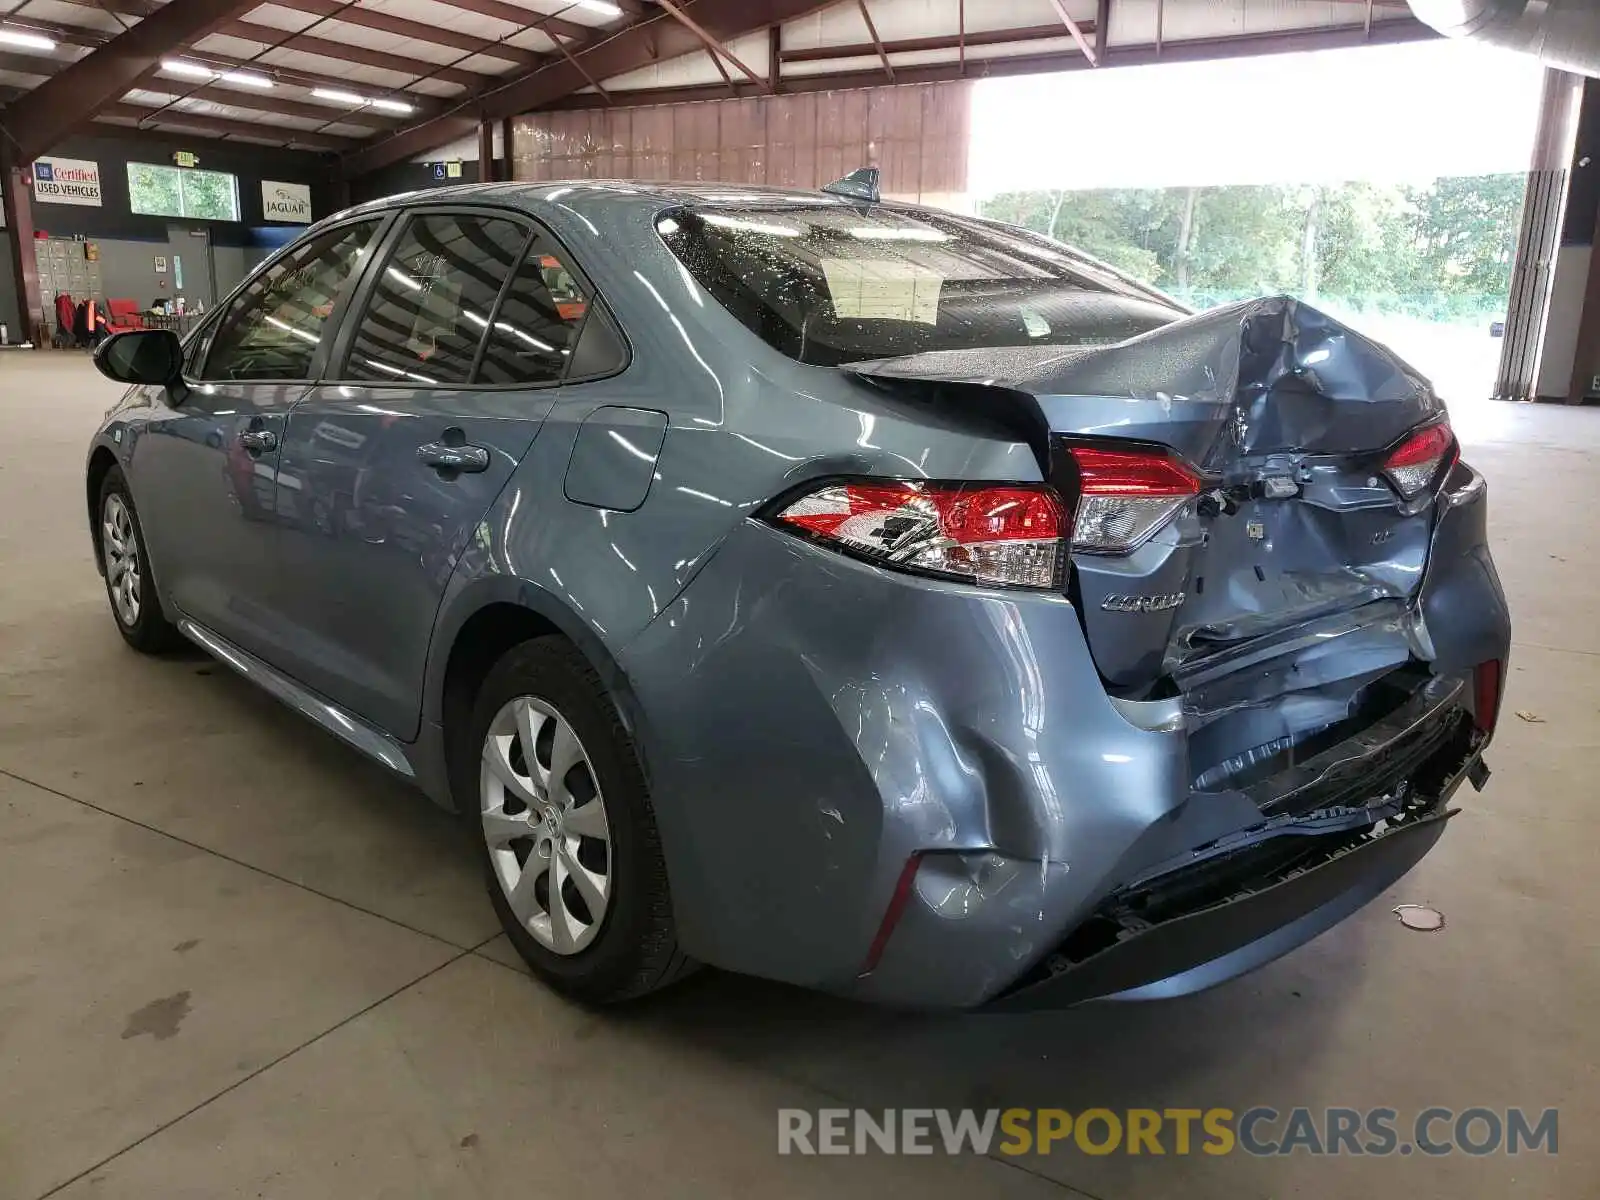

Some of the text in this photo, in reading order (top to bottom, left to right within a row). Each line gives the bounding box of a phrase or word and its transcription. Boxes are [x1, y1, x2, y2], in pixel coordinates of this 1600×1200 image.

[54, 167, 97, 182] Certified
[37, 183, 99, 198] USED VEHICLES
[267, 201, 304, 214] JAGUAR
